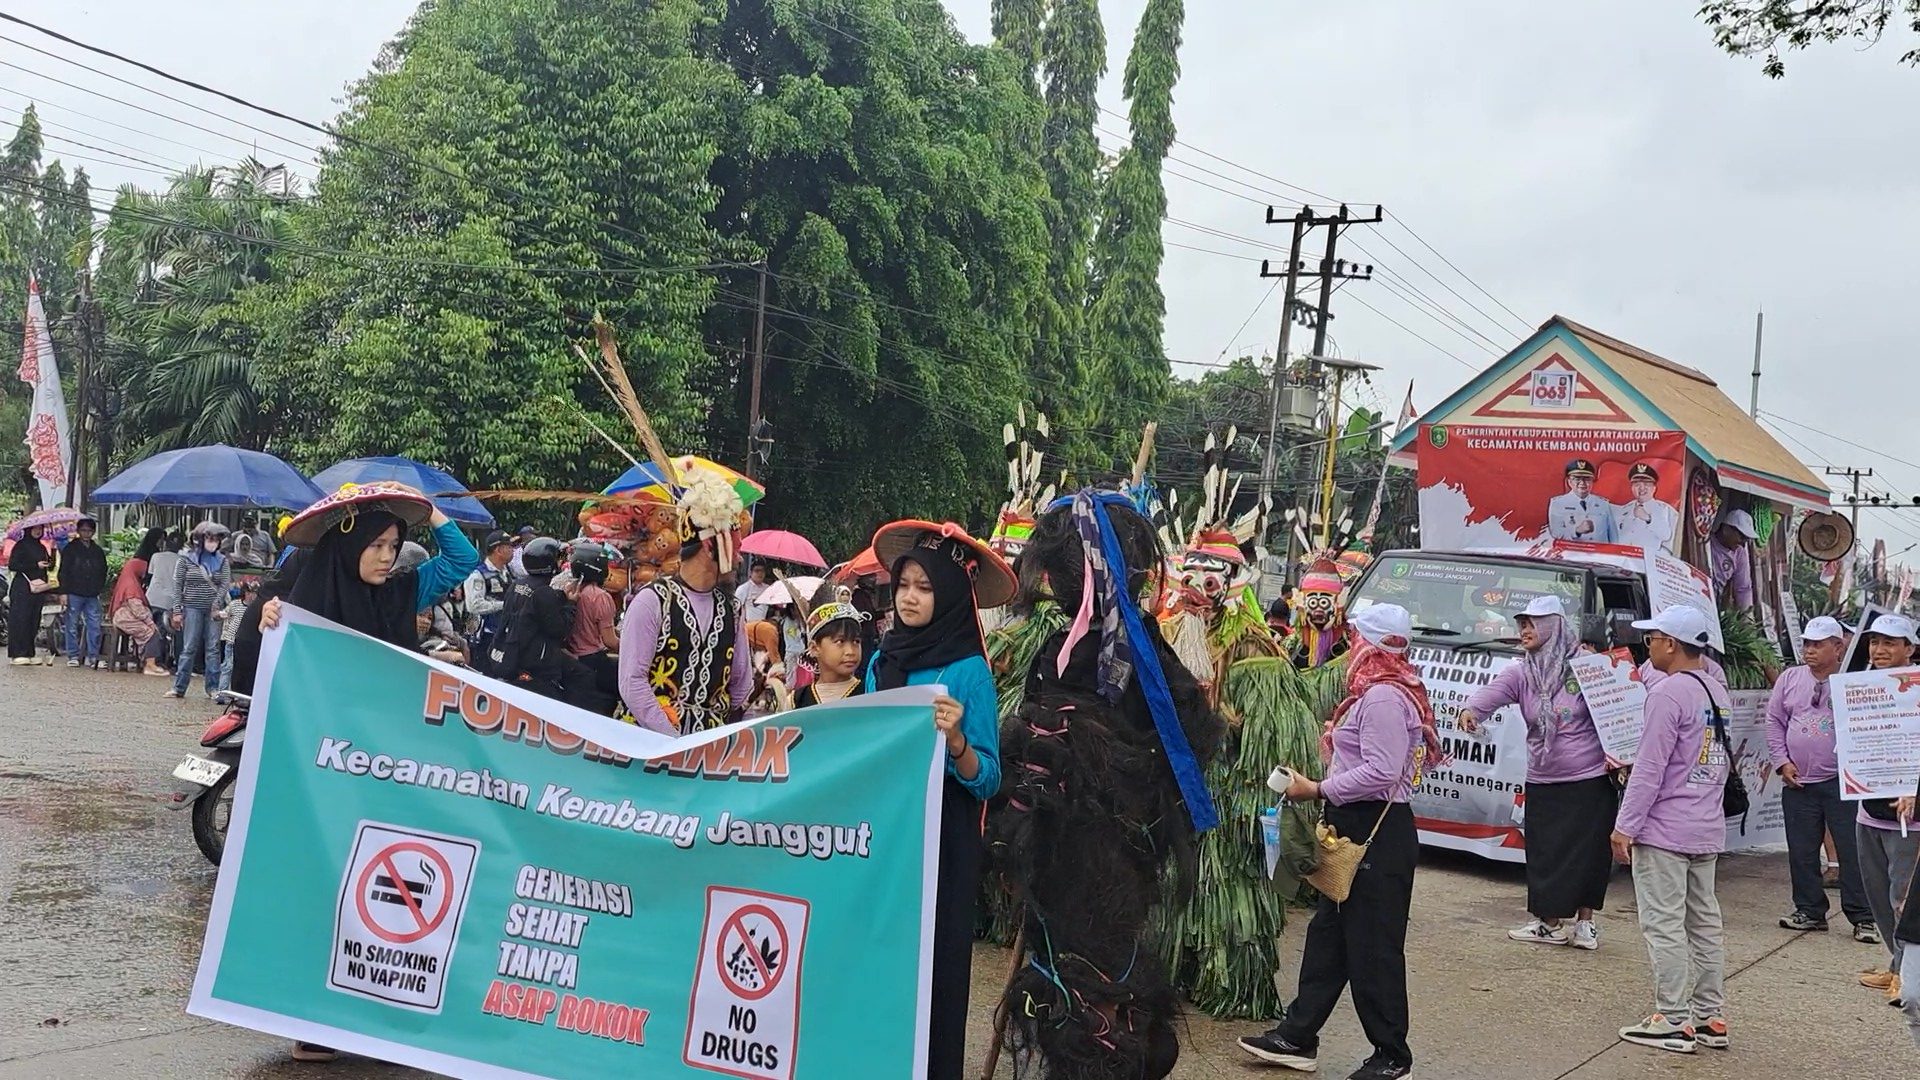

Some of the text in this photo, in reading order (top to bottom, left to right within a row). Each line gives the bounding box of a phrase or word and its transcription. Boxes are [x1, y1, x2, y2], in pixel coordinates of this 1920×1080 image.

[1456, 428, 1660, 440] PEMERINTAH KABUPATEN KUTAI KARTANEGARA
[1467, 438, 1647, 453] KECAMATAN KEMBANG JANGGUT
[1845, 687, 1887, 697] REPUBLIK
[1846, 694, 1895, 705] INDONESIA
[316, 737, 872, 859] Kecamatan Kembang Janggut
[515, 865, 632, 917] GENERASI
[505, 903, 589, 948] SEHAT
[344, 939, 437, 974] NO SMOKING
[498, 942, 579, 988] TANPA
[347, 961, 426, 993] NO VAPING
[483, 981, 650, 1046] ASAP ROKOK
[728, 1005, 756, 1034] NO
[701, 1031, 778, 1070] DRUGS
